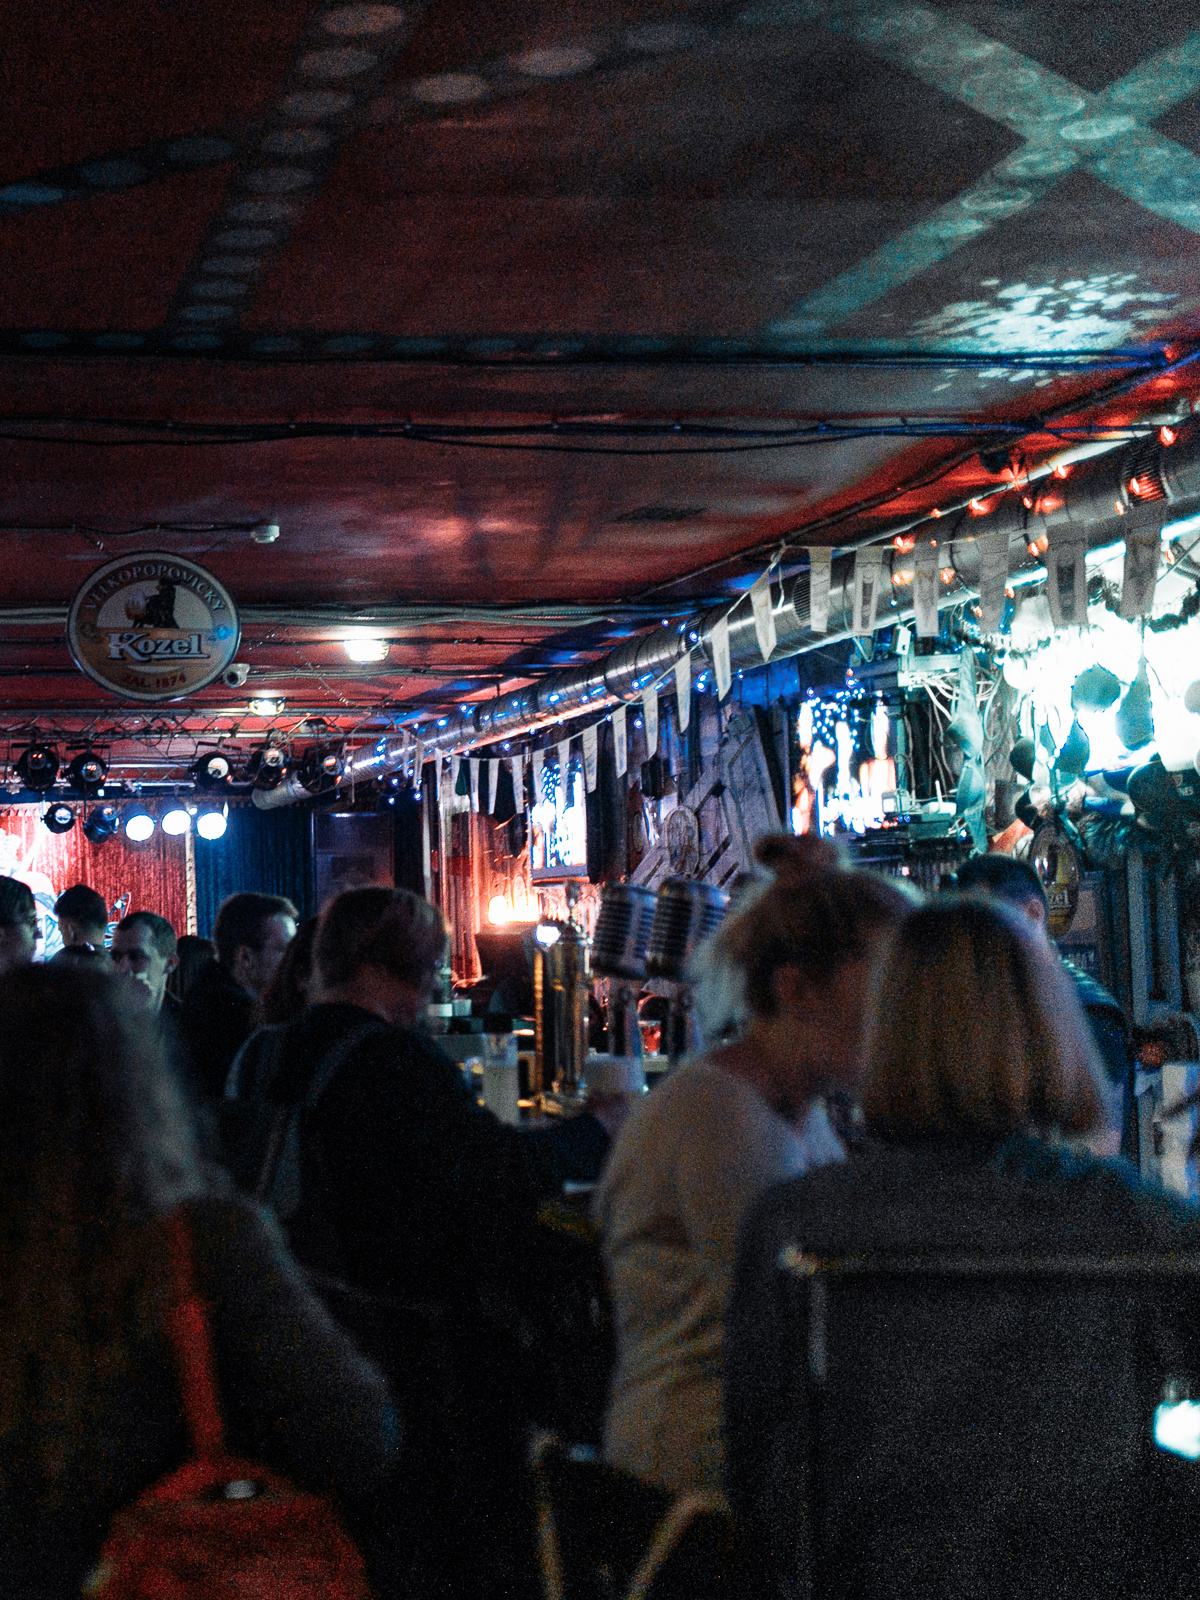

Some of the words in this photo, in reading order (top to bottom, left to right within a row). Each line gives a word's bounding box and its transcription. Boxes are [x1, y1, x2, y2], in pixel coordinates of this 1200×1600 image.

[107, 632, 210, 662] Kozel
[155, 672, 187, 688] 1874
[1048, 888, 1072, 910] zel
